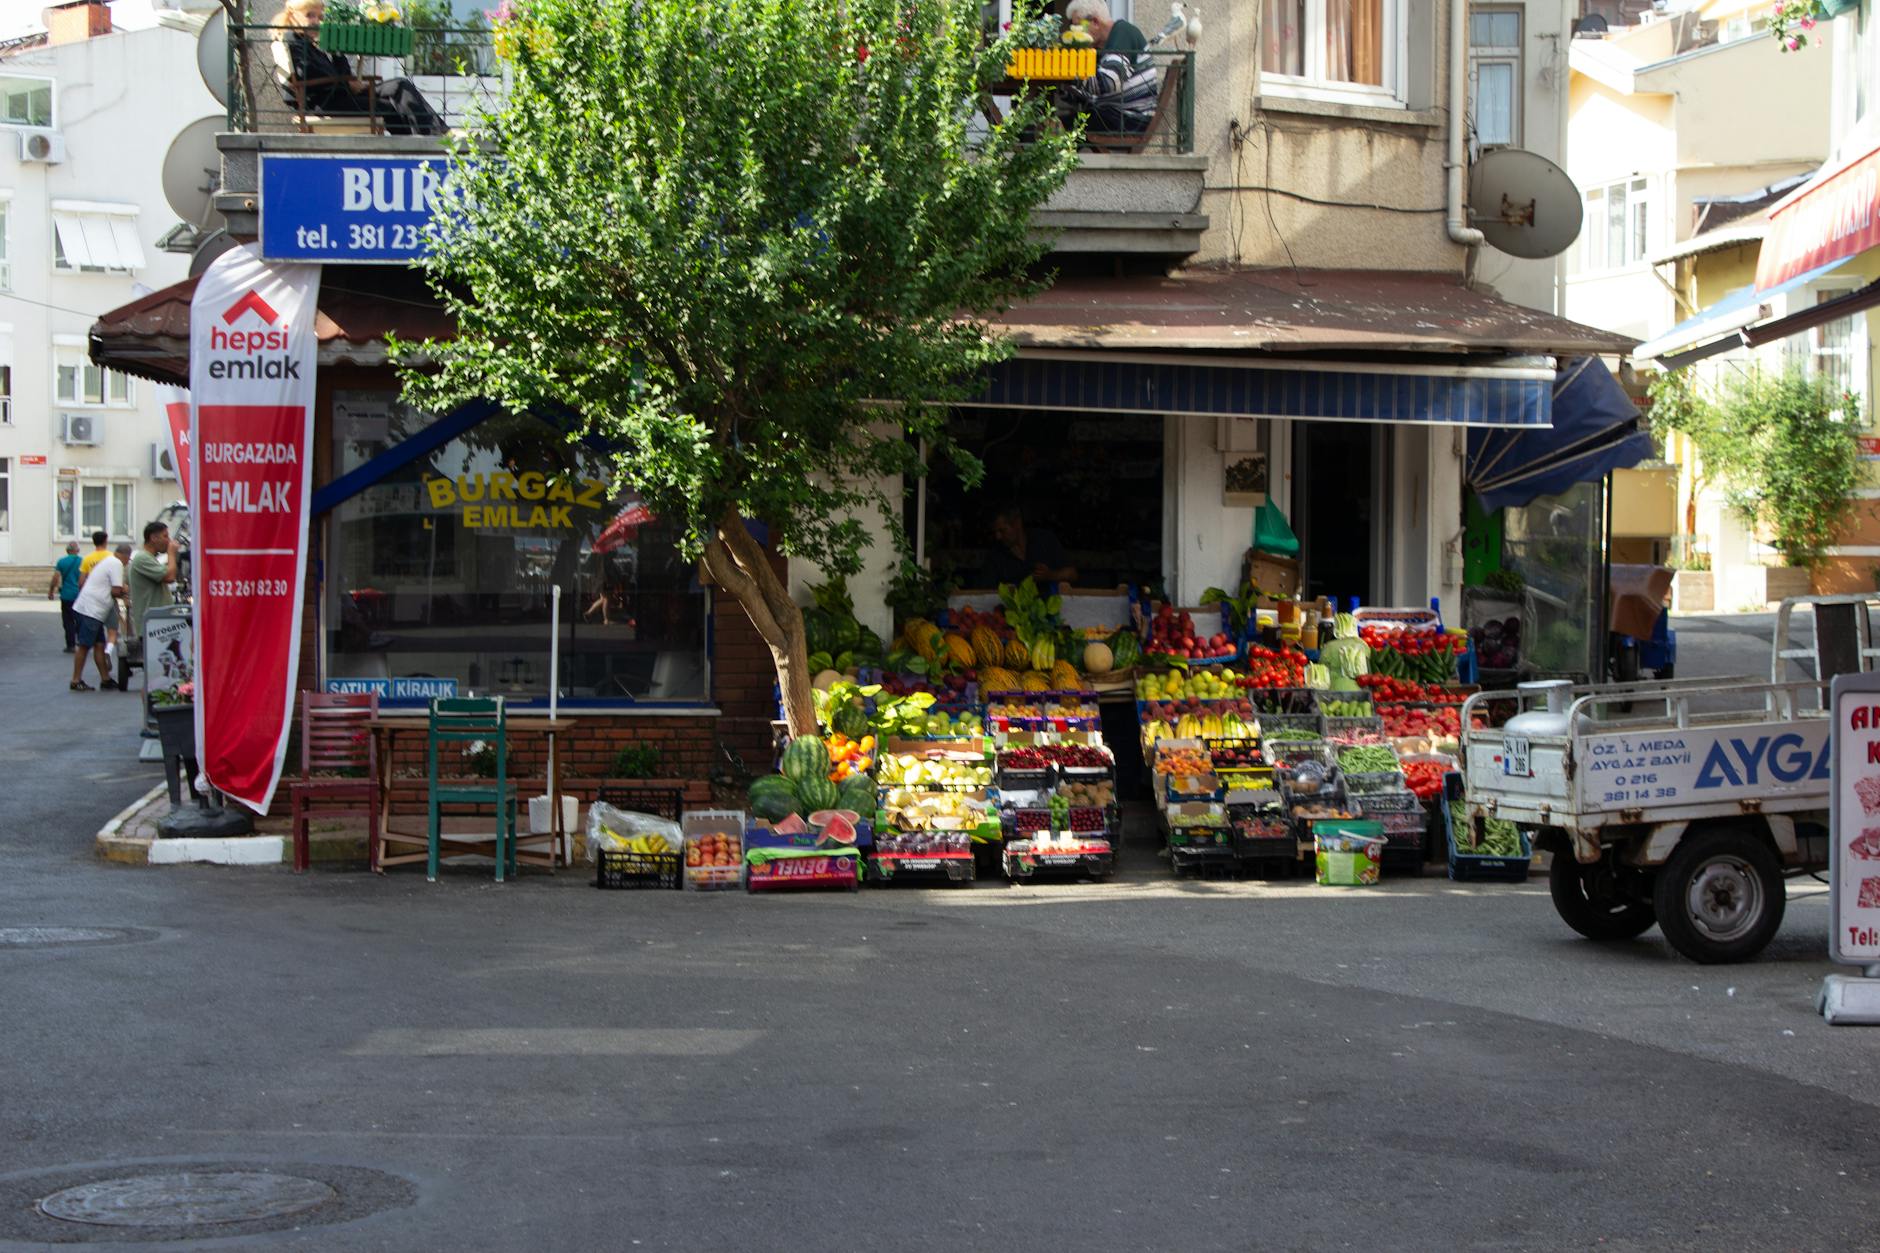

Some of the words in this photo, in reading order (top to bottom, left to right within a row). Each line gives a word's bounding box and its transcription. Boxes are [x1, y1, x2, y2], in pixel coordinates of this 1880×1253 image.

[296, 224, 338, 249] tel.
[348, 224, 385, 249] 381
[391, 224, 418, 249] 23
[210, 324, 289, 355] hepsi
[208, 355, 300, 379] emlak
[204, 443, 297, 464] BURGAZADA
[207, 481, 291, 513] EMLAK
[427, 471, 606, 509] BURGAZ
[463, 505, 574, 528] EMLAK
[235, 580, 256, 596] 261
[257, 580, 272, 596] 82
[274, 580, 288, 596] 30
[396, 680, 453, 697] KİRALIK
[1639, 740, 1686, 752] MEDA
[1630, 774, 1658, 785] 216
[1603, 791, 1630, 802] 381
[1635, 789, 1650, 799] 14
[1655, 787, 1677, 798] 38
[1848, 926, 1879, 946] Tel:
